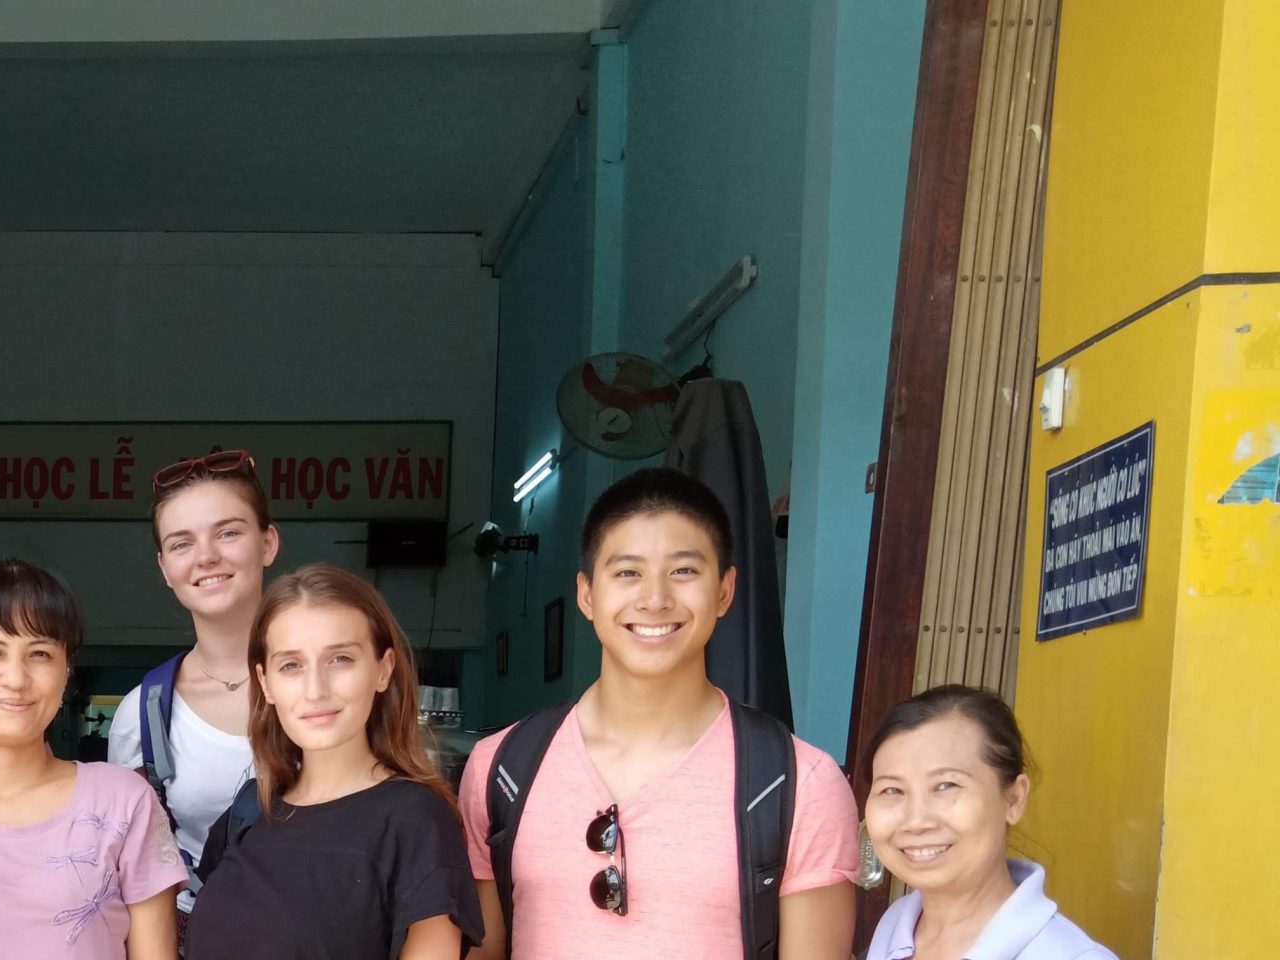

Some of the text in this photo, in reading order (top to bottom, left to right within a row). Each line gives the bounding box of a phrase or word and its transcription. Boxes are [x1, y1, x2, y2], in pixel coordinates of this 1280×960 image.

[0, 457, 75, 509] HỌC
[89, 436, 135, 499] LỄ
[271, 457, 351, 509] HỌC
[365, 447, 444, 500] VĂN
[1055, 543, 1069, 570] CON
